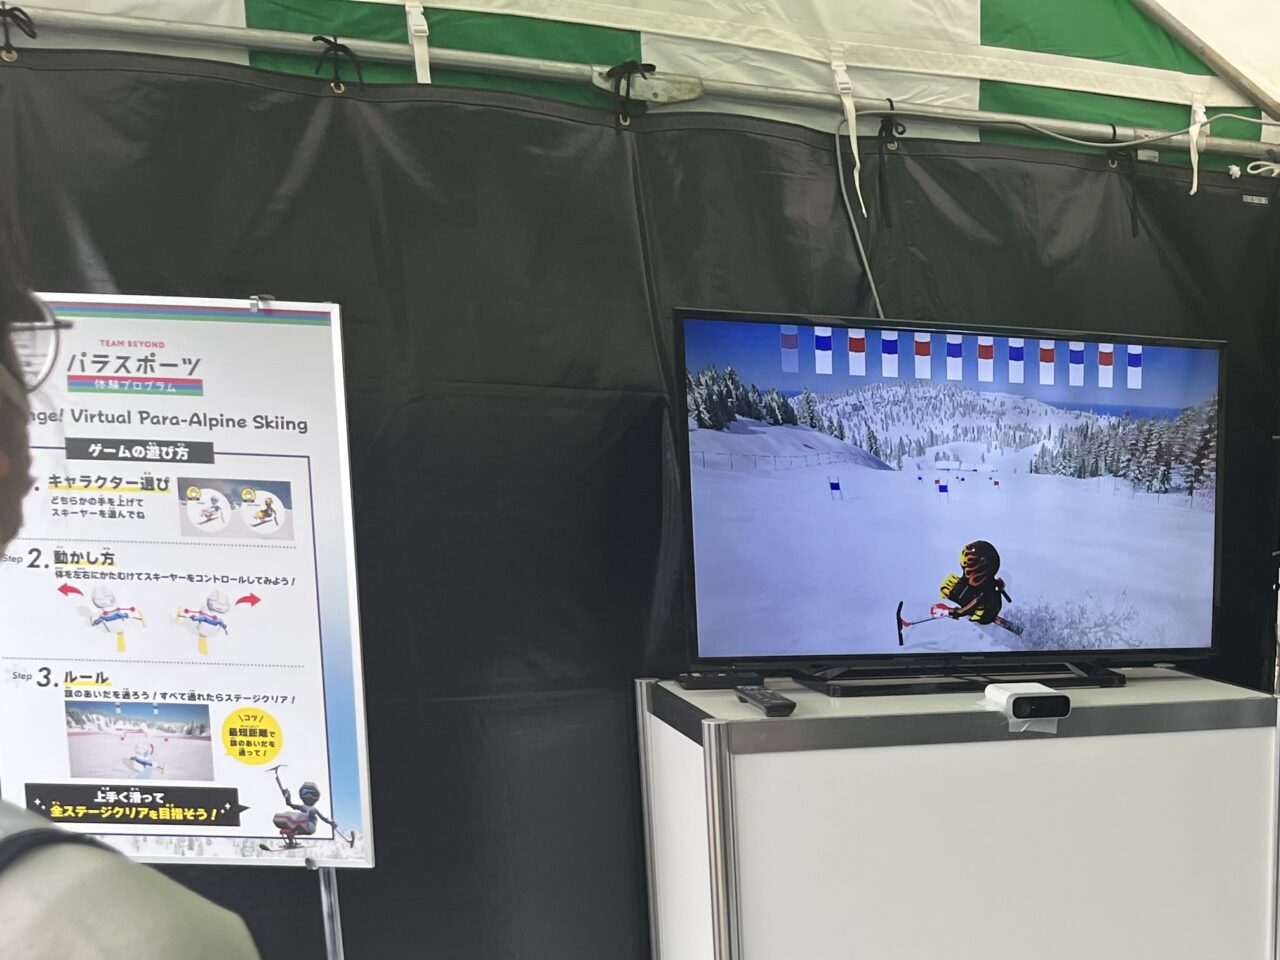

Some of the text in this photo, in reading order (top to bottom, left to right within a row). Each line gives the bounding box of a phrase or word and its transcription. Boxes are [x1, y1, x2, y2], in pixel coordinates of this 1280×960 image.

[66, 352, 201, 376] パラスポーツ
[94, 378, 177, 392] 体験プログラム
[71, 408, 131, 425] Virtual
[138, 411, 248, 431] Para-Alpine
[252, 415, 308, 434] Skiing
[88, 443, 189, 460] ゲームの遊び方
[49, 474, 170, 491] キャラクター選び
[51, 496, 144, 507] どちらかの手を上げて
[2, 548, 115, 568] Step 2. 動かし方
[12, 667, 109, 688] Step 3. ルール
[94, 790, 164, 804] 上手く滑って
[50, 805, 217, 821] 全ステージクリアを目指そう！
